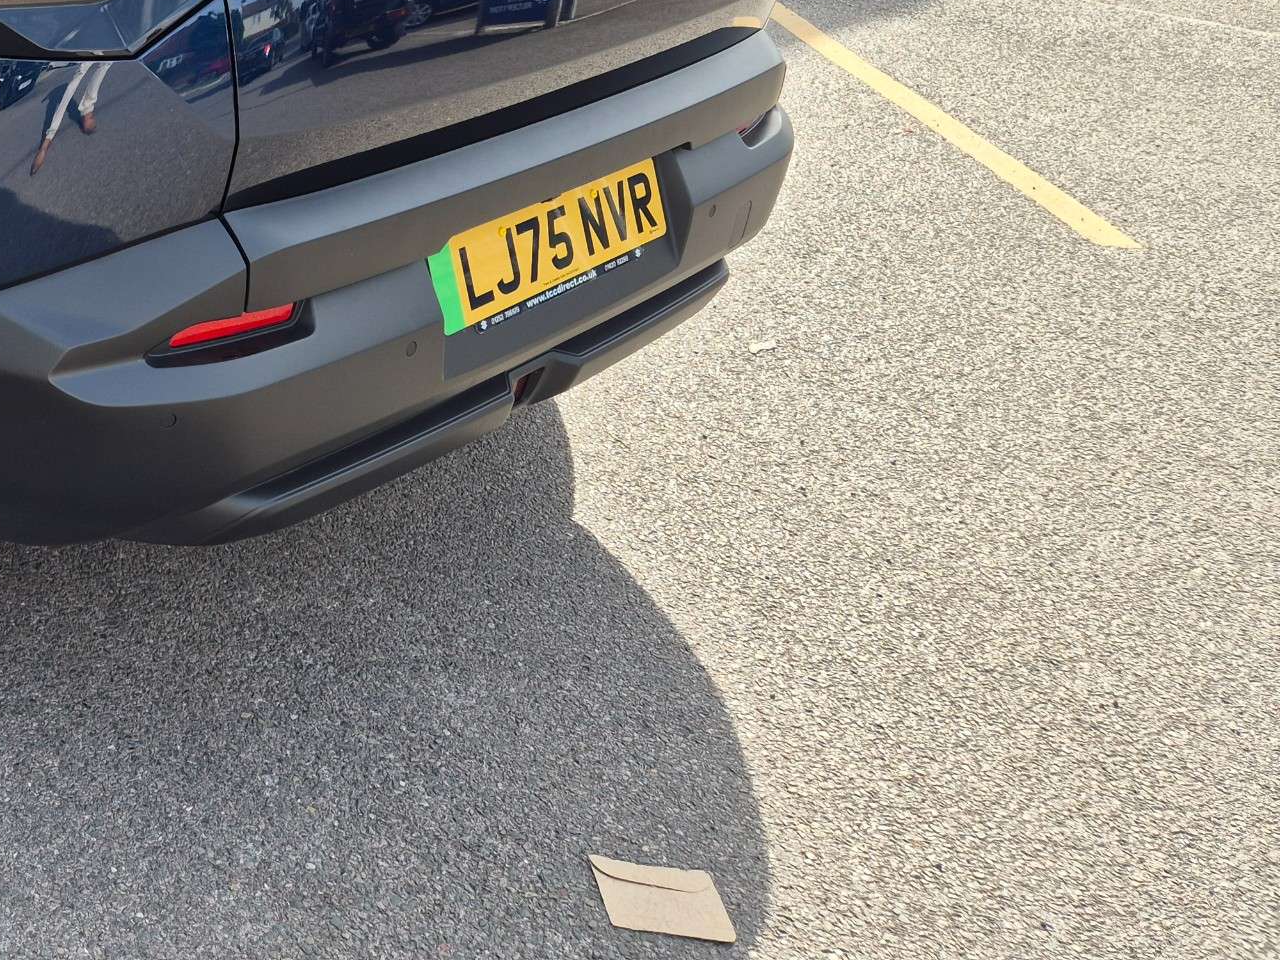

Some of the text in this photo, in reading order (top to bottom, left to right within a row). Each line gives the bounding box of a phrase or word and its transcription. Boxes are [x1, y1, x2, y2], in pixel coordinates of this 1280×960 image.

[458, 171, 658, 311] LJ75 NVR
[525, 268, 598, 309] www.tccdirect.co.uk
